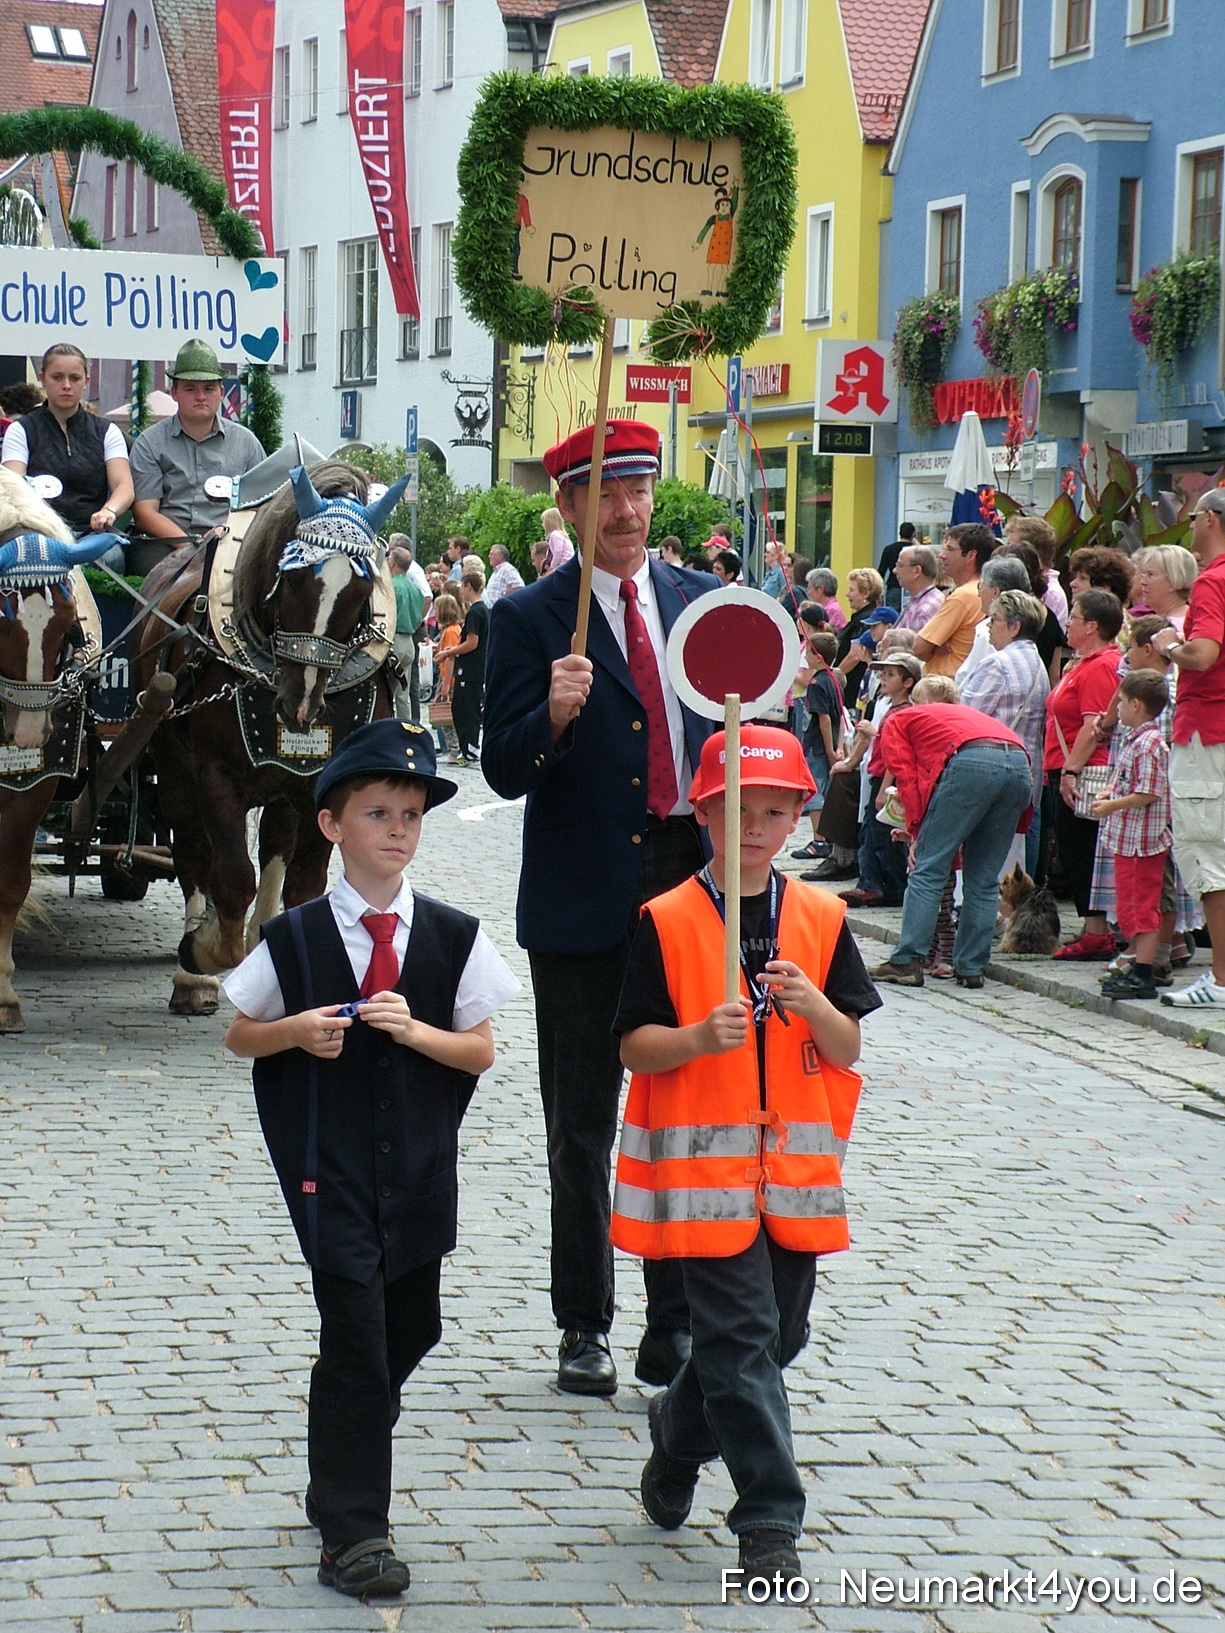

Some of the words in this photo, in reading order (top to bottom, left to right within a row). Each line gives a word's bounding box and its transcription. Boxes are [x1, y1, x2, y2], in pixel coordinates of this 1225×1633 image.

[521, 131, 729, 187] Grundschule
[104, 272, 237, 349] Pölling
[729, 365, 738, 391] P
[577, 400, 637, 428] Resurant
[408, 413, 416, 448] P
[740, 746, 783, 761] Cargo
